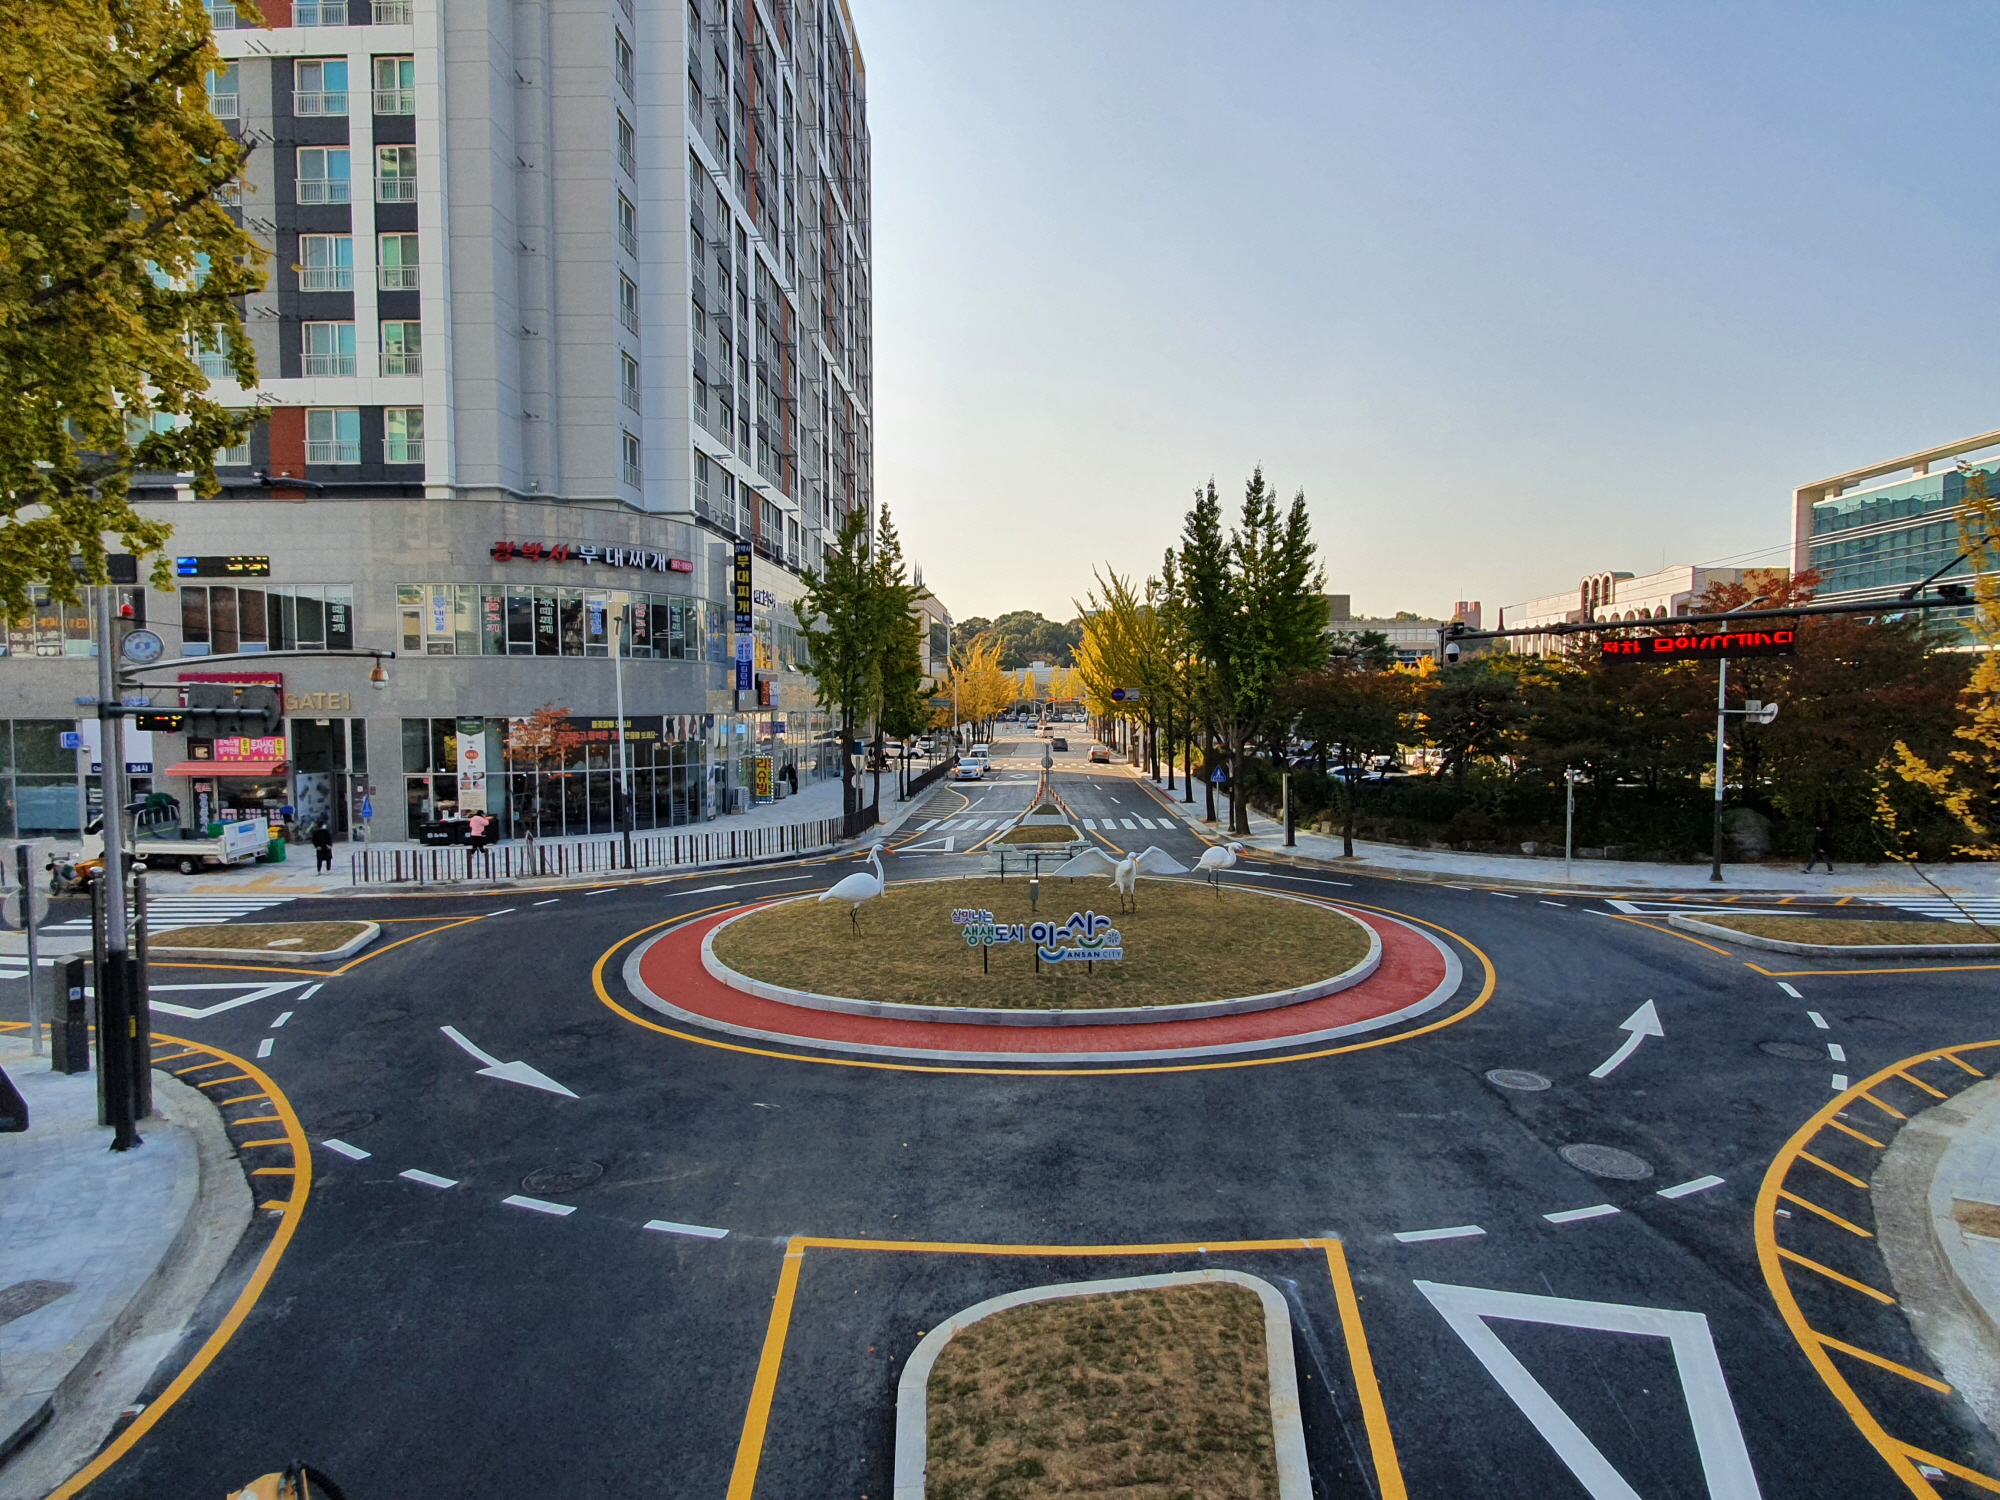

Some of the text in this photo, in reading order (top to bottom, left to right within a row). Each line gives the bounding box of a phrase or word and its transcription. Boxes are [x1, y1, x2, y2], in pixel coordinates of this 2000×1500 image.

[493, 541, 570, 563] 장박사
[578, 544, 667, 573] 부대찌개
[736, 555, 750, 613] 부대찌개
[284, 692, 350, 710] GATE1
[952, 910, 993, 923] 살맛나는
[963, 912, 1110, 962] 생생도시 안산
